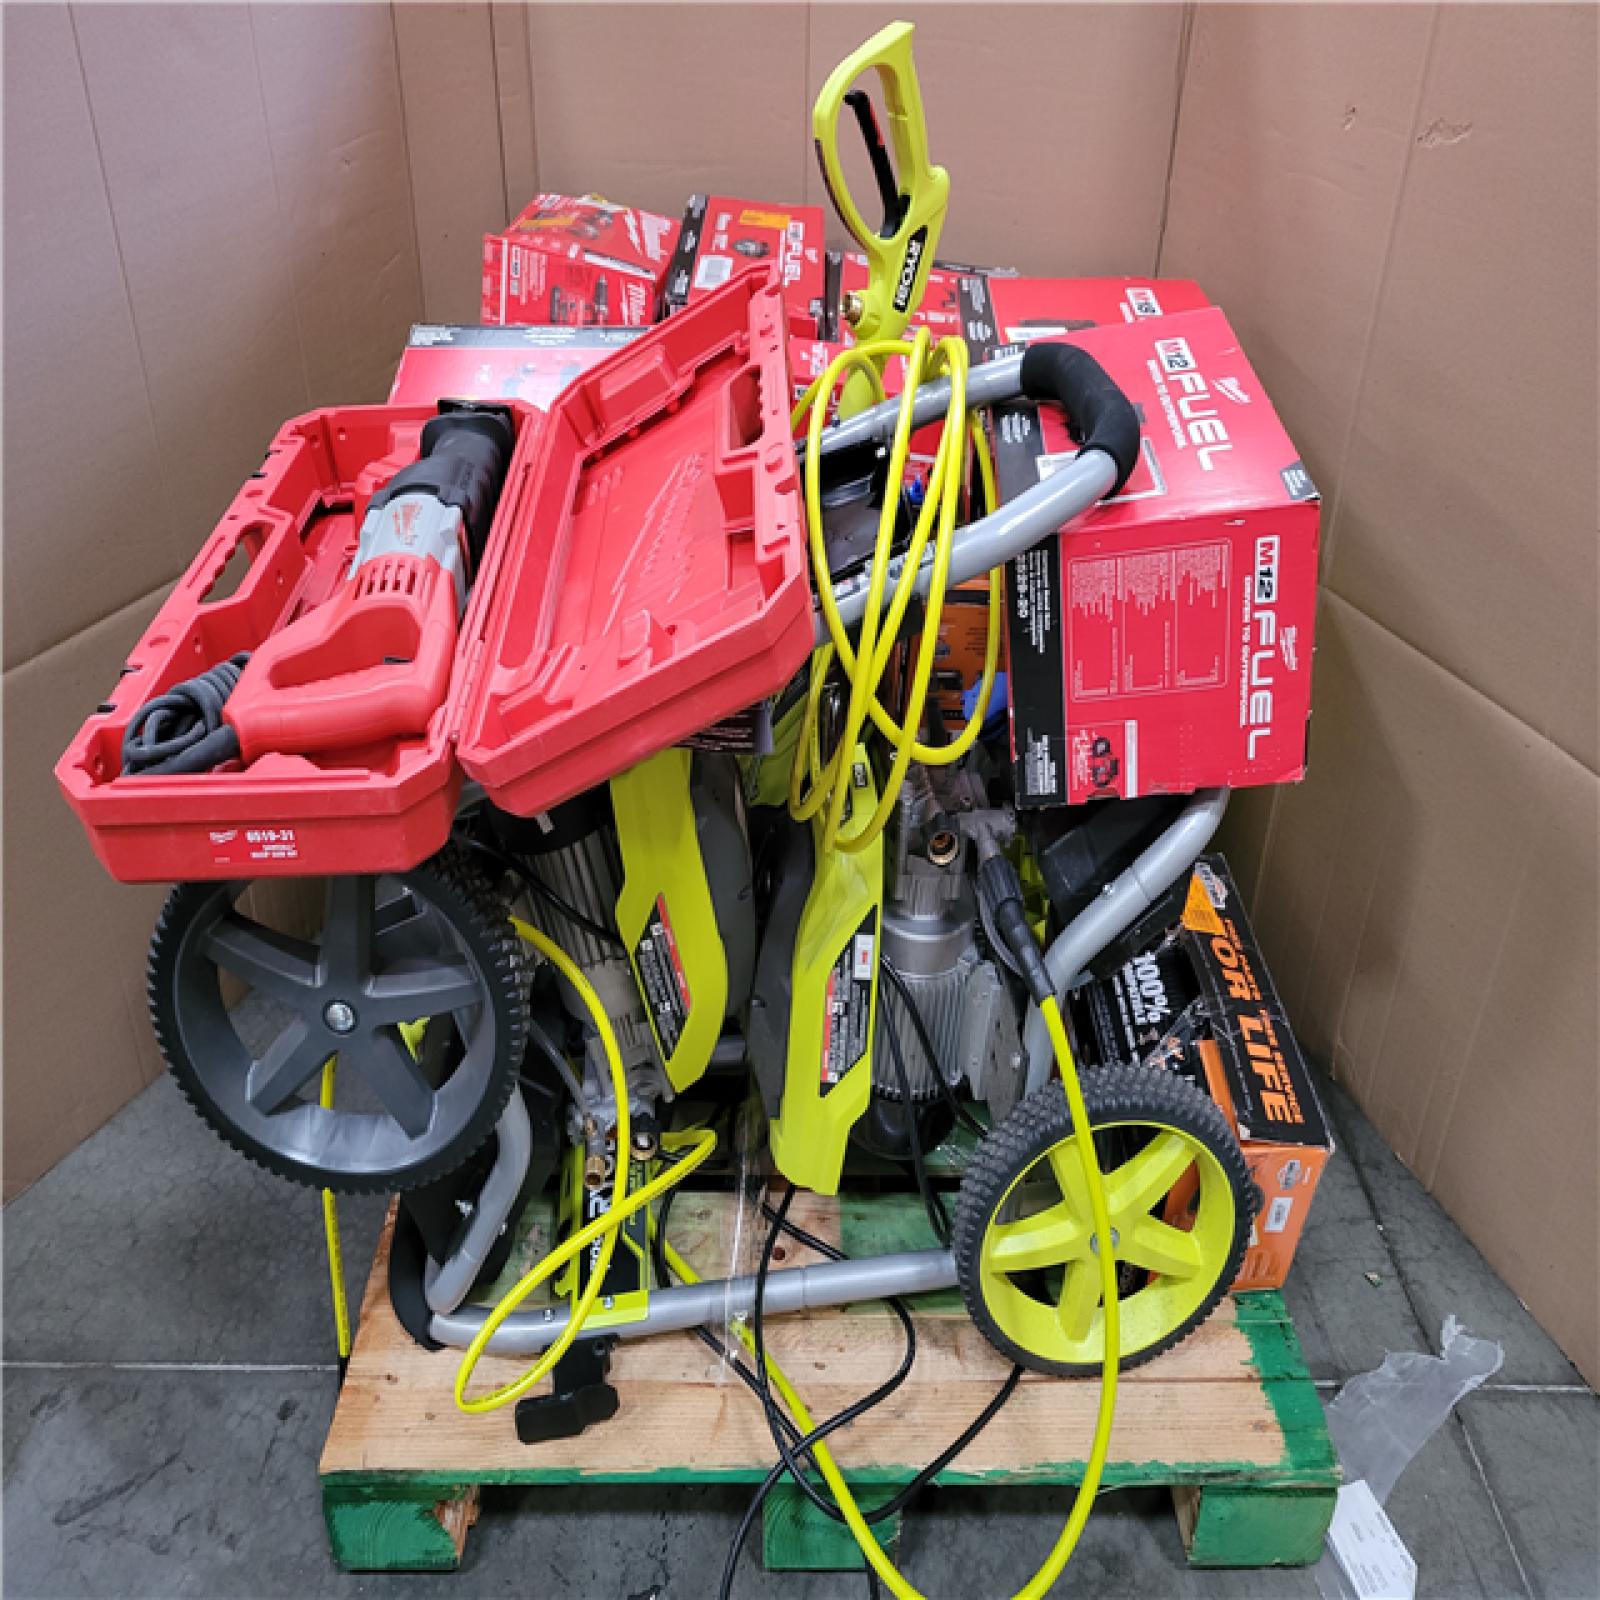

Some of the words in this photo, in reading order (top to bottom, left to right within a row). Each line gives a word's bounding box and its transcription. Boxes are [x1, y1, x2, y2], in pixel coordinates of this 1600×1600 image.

[895, 240, 921, 305] RYOBI
[1156, 340, 1194, 371] M12
[1167, 373, 1234, 470] FUEL
[1257, 539, 1277, 601] M12
[1248, 610, 1276, 760] FUEL
[1133, 951, 1171, 1022] 100%
[1210, 936, 1252, 1001] OR
[1237, 1015, 1290, 1122] LIFE
